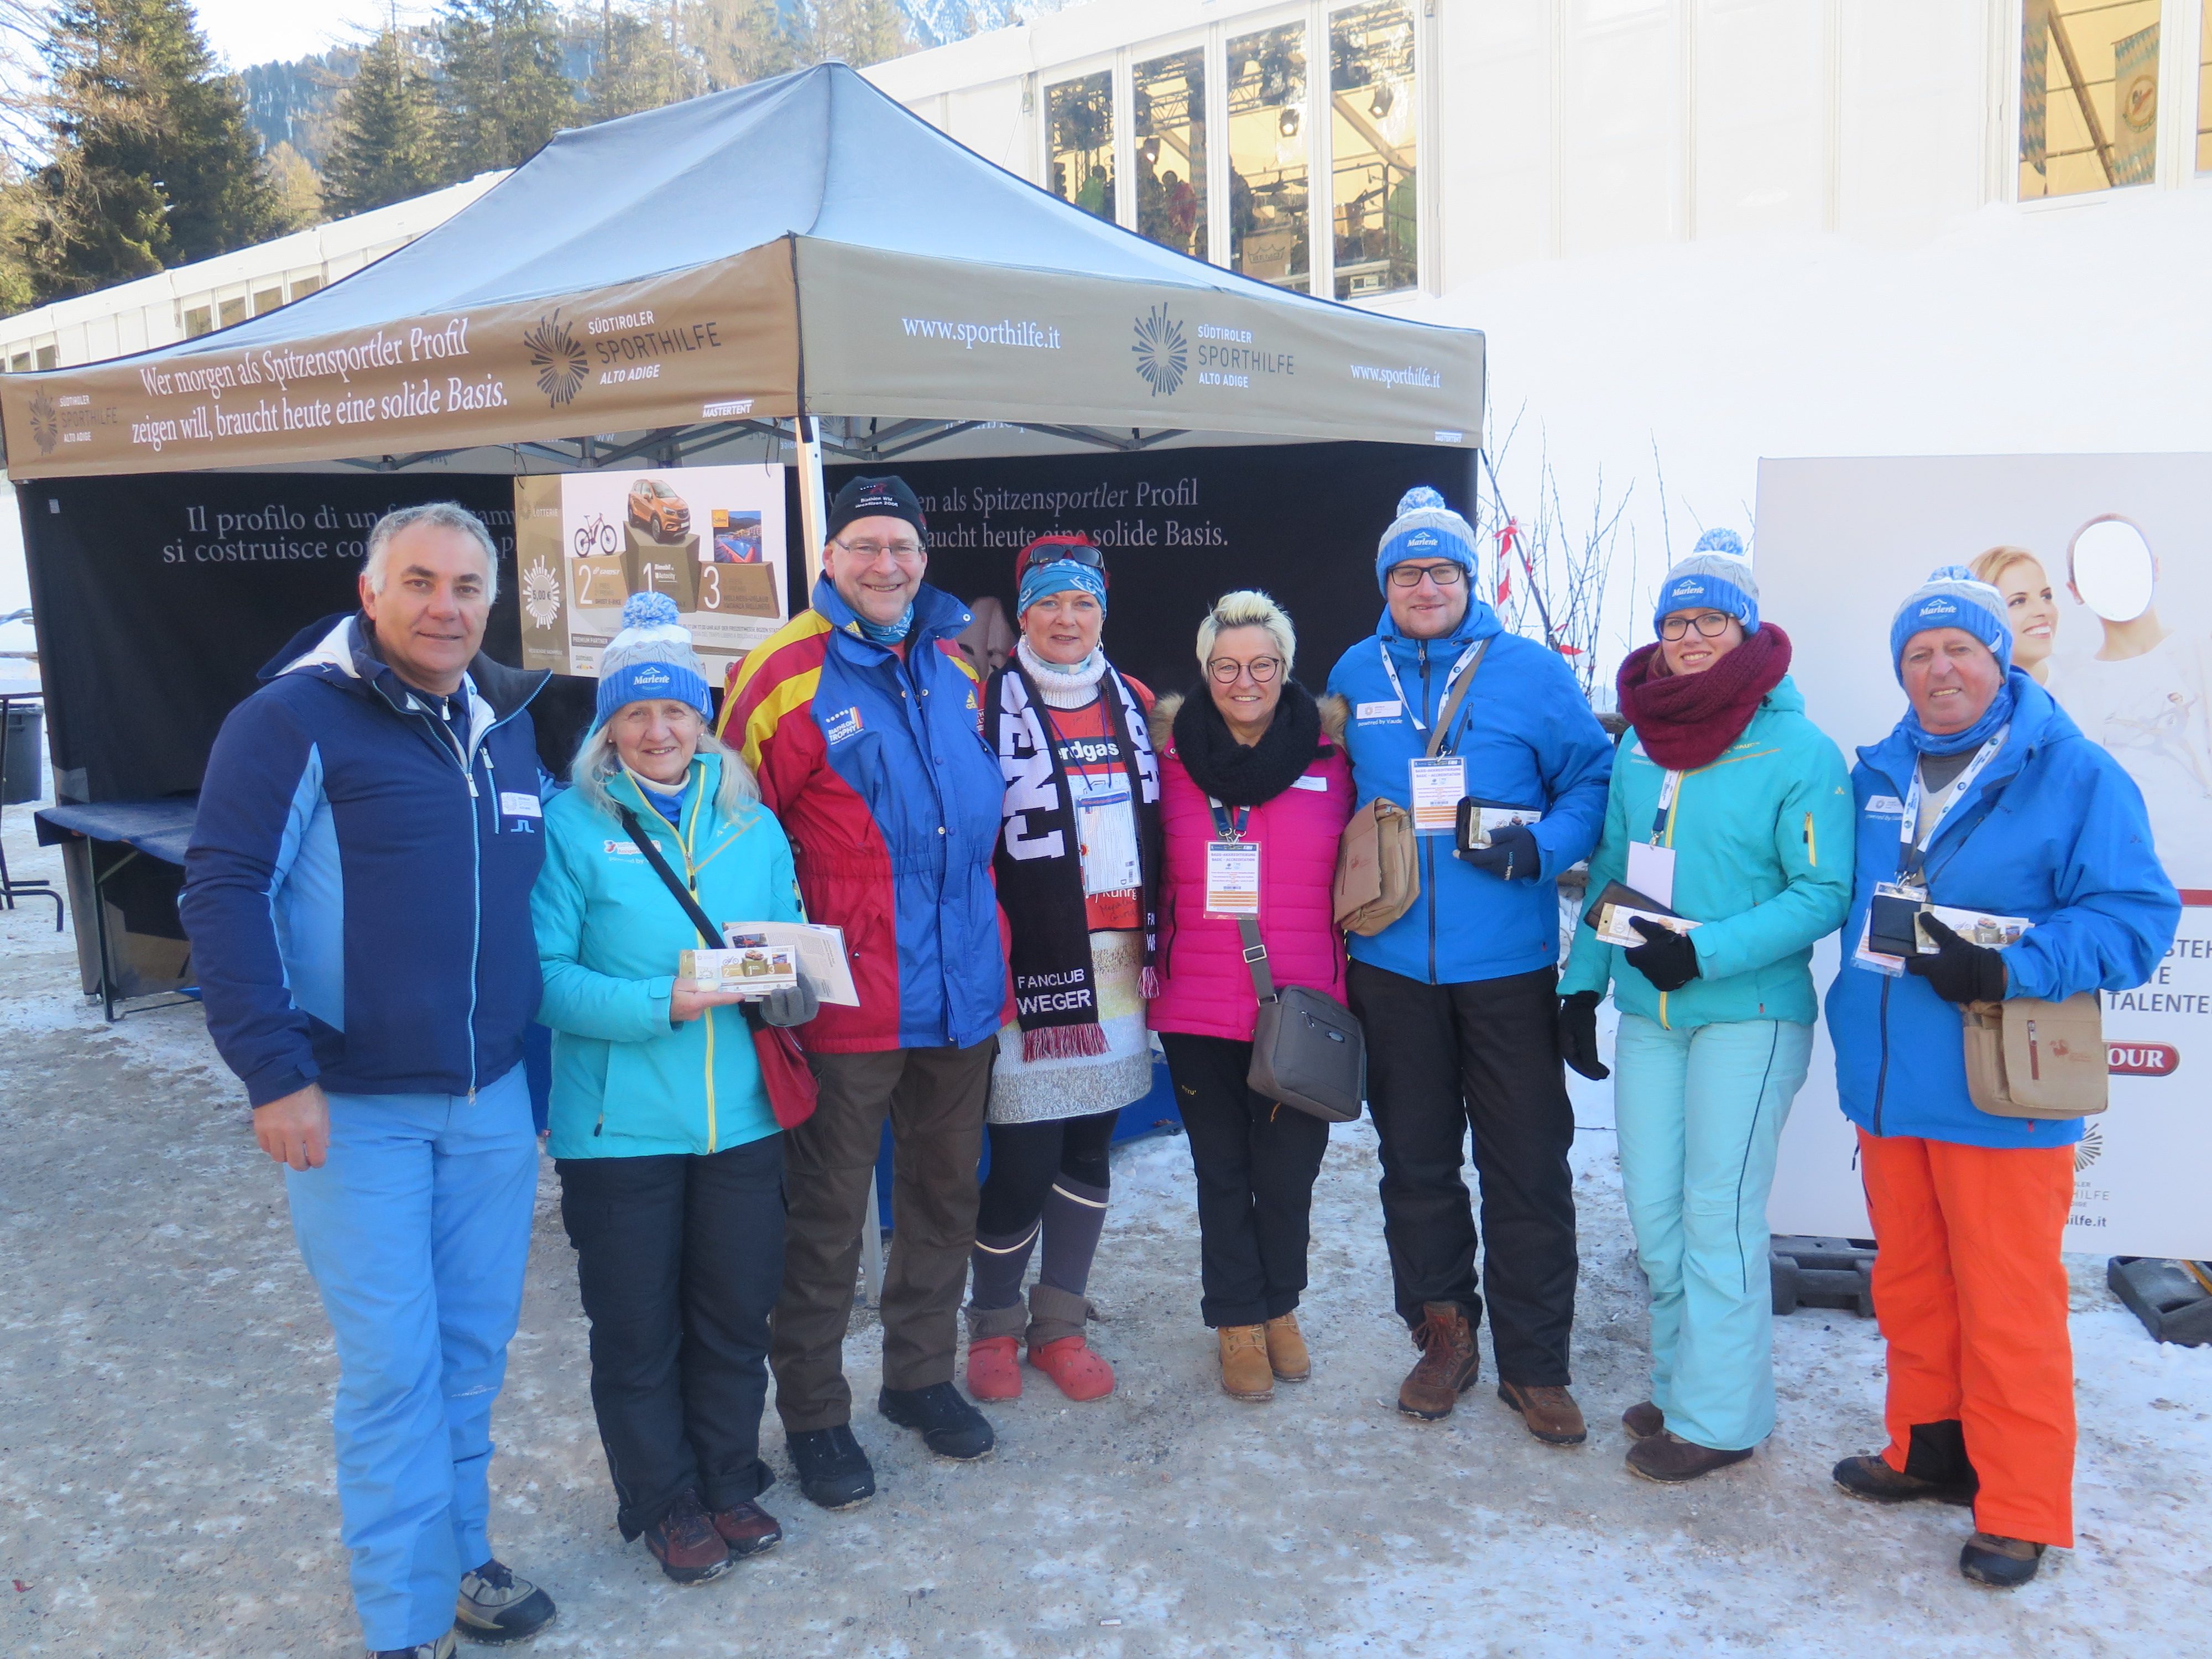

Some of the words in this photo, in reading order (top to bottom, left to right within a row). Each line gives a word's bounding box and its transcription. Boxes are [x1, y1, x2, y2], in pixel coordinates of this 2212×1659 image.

[588, 310, 655, 335] SÜDTIROLER
[901, 317, 1061, 349] www.sporthilfe.it
[1198, 324, 1252, 343] SÜDTIROLER
[596, 322, 721, 364] SPORTHILFE
[140, 367, 173, 397] Wer
[175, 365, 237, 399] morgen
[237, 352, 262, 385] als
[263, 331, 403, 391] Spitzensportler
[410, 317, 469, 362] Profil
[1199, 345, 1294, 375] SPORTHILFE
[599, 369, 625, 385] ALTO
[628, 364, 661, 381] ADIGE
[1199, 372, 1220, 385] ALTO
[1223, 374, 1249, 388] ADIGE
[1350, 365, 1441, 389] www.sporthilfe.it
[61, 407, 118, 427] SPORTHILFE
[132, 415, 178, 452] zeigen
[180, 405, 213, 441] will,
[215, 399, 279, 436] braucht
[281, 397, 331, 431] heute
[336, 392, 375, 424] eine
[380, 379, 441, 420] solide
[447, 373, 508, 412] Basis.
[702, 404, 753, 418] MASTERTENT
[64, 433, 75, 442] ALTO
[943, 487, 967, 512] als
[973, 482, 1128, 519] Spitzensportler
[1135, 478, 1198, 507] Profil
[186, 505, 207, 532] Il
[217, 504, 305, 539] profilo
[315, 504, 340, 529] di
[347, 512, 378, 529] un
[927, 523, 977, 547] aucht
[983, 523, 1036, 547] heute
[1093, 519, 1157, 547] solide
[1165, 520, 1228, 546] Basis.
[163, 538, 186, 563] si
[195, 536, 328, 561] costruisce
[1407, 538, 1438, 547] Marlene
[579, 565, 593, 604] 2
[643, 562, 653, 592] 1
[703, 566, 720, 609] 3
[533, 589, 546, 601] 5,00
[547, 591, 552, 601] €
[1672, 586, 1704, 597] Marlene
[1918, 605, 1957, 617] Marlene
[633, 674, 670, 686] Marlene
[828, 720, 856, 735] BIATHLON
[828, 724, 857, 742] TROPHY
[1018, 968, 1085, 989] FANCLUB
[1016, 988, 1092, 1015] WEGER
[2107, 992, 2212, 1014] TALENTE
